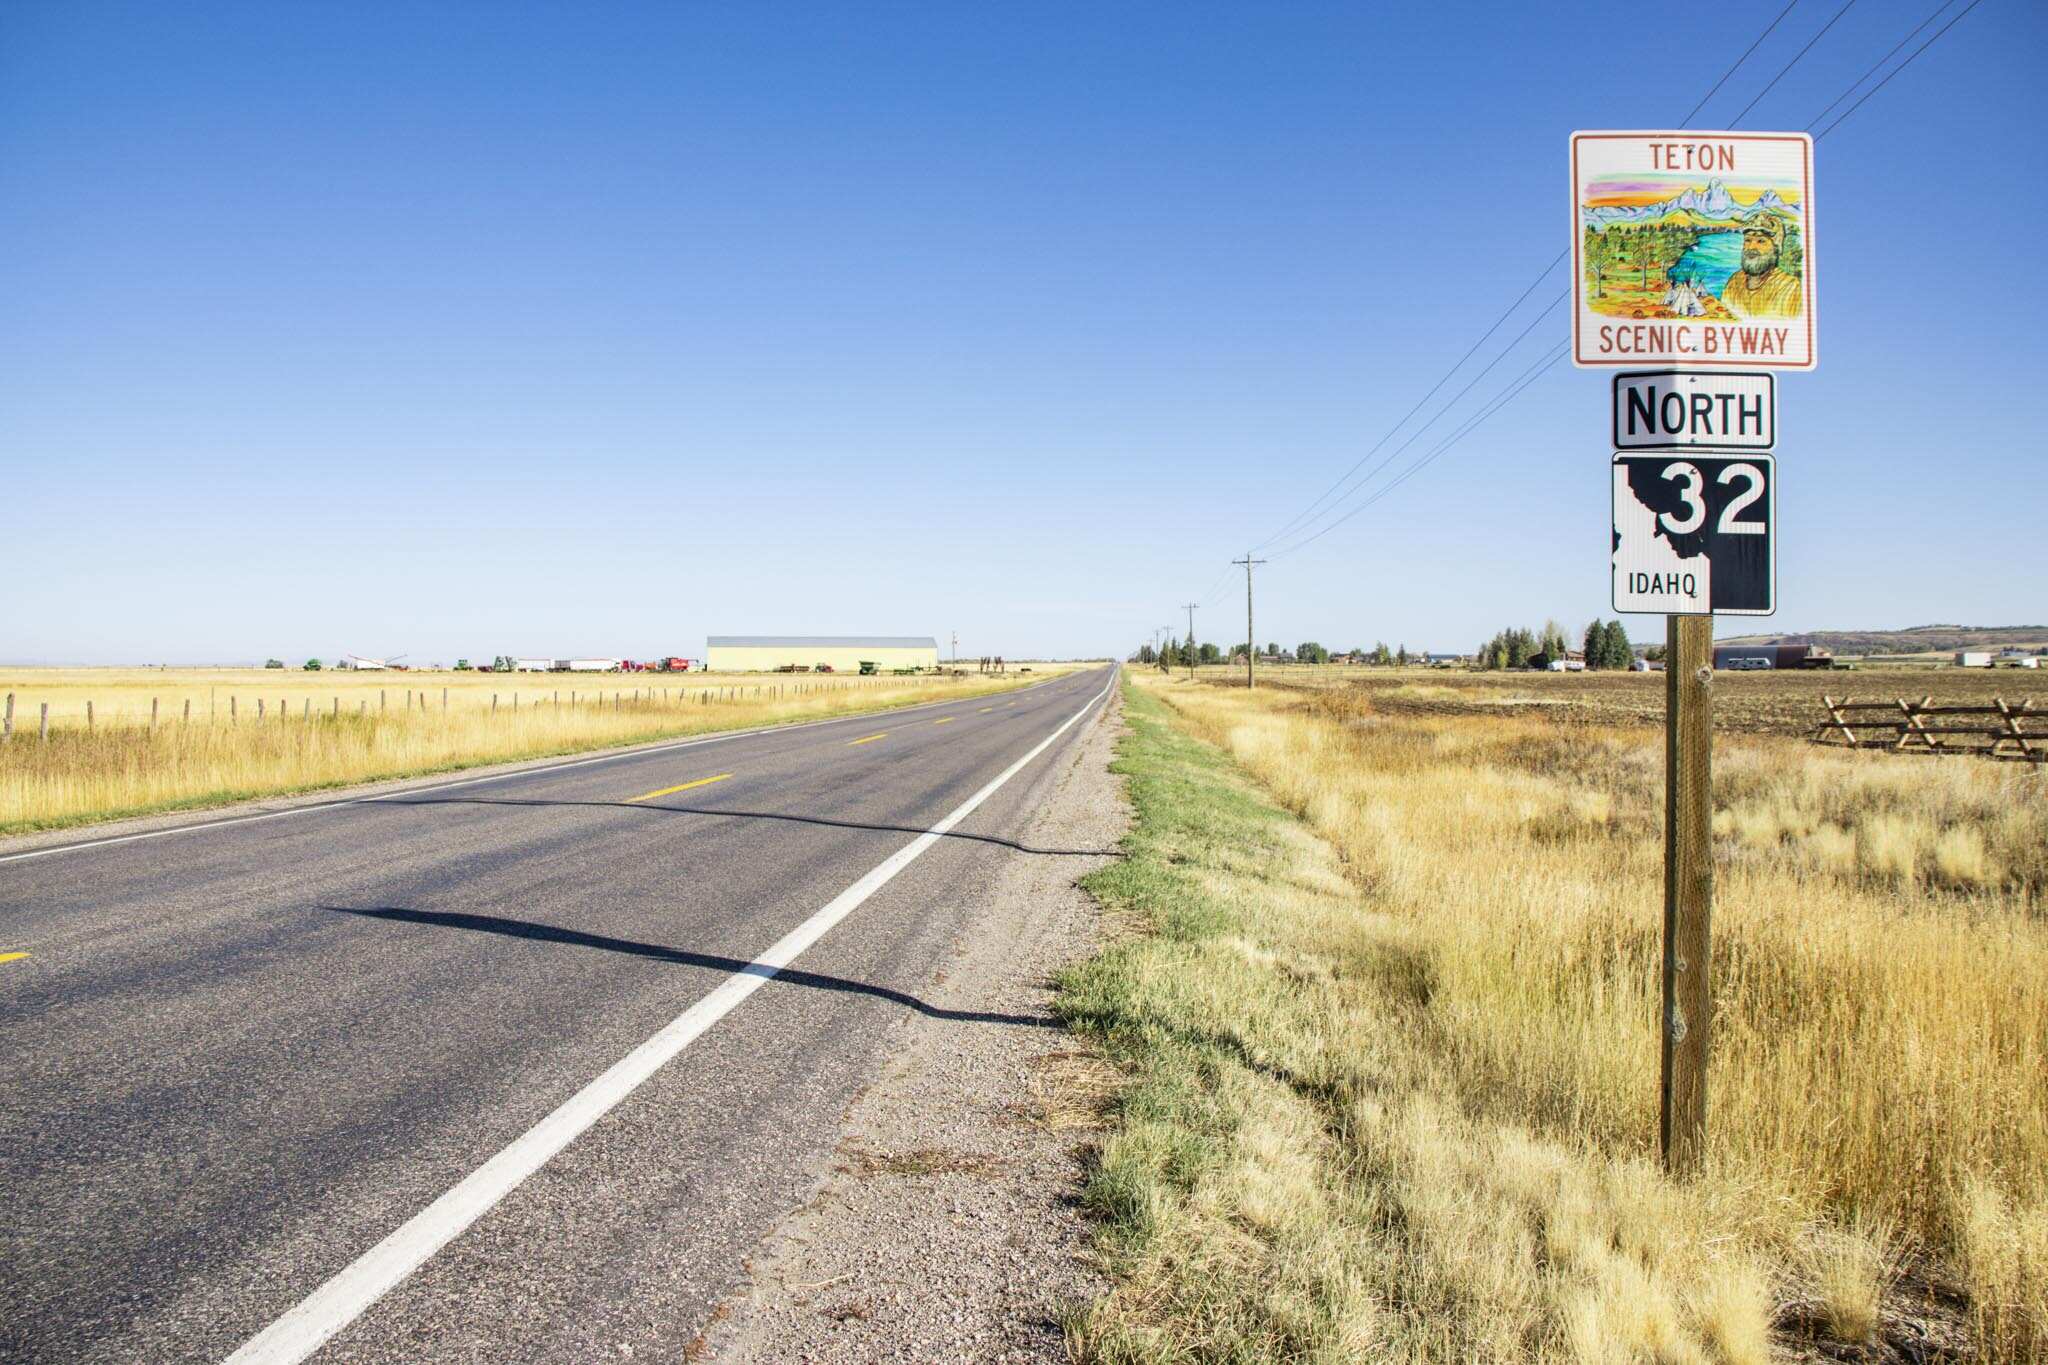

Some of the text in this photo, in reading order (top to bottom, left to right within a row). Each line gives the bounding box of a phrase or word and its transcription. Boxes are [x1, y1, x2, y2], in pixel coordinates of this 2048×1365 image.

[1649, 143, 1735, 171] TETON
[1599, 325, 1790, 356] SCENIC BYWAY
[1627, 385, 1763, 436] NORTH
[1659, 461, 1767, 535] 32
[1629, 572, 1697, 595] IDAHO
